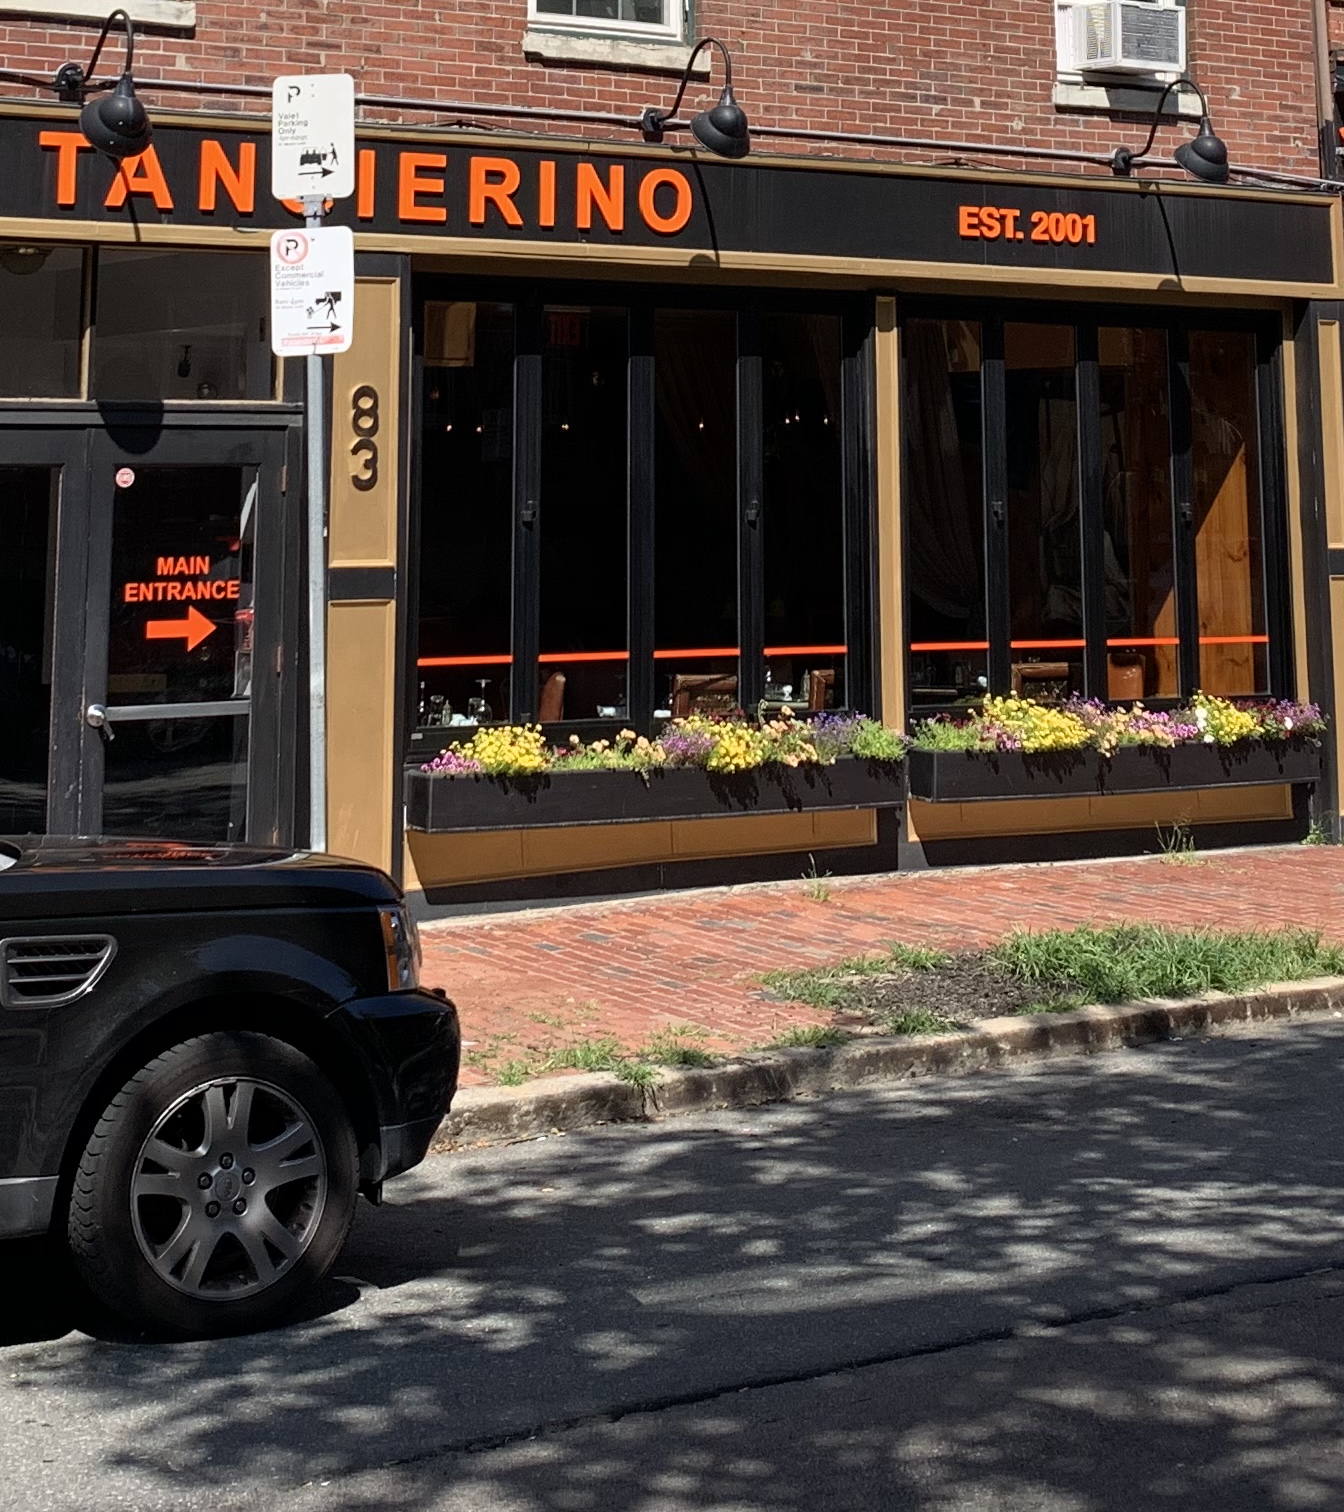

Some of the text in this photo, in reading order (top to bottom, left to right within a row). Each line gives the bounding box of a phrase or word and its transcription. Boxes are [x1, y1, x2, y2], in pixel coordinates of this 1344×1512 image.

[39, 130, 694, 234] TANIERINO
[959, 205, 1096, 245] EST. 2001
[157, 555, 210, 576] MAIN
[124, 579, 240, 603] ENTRANCE
